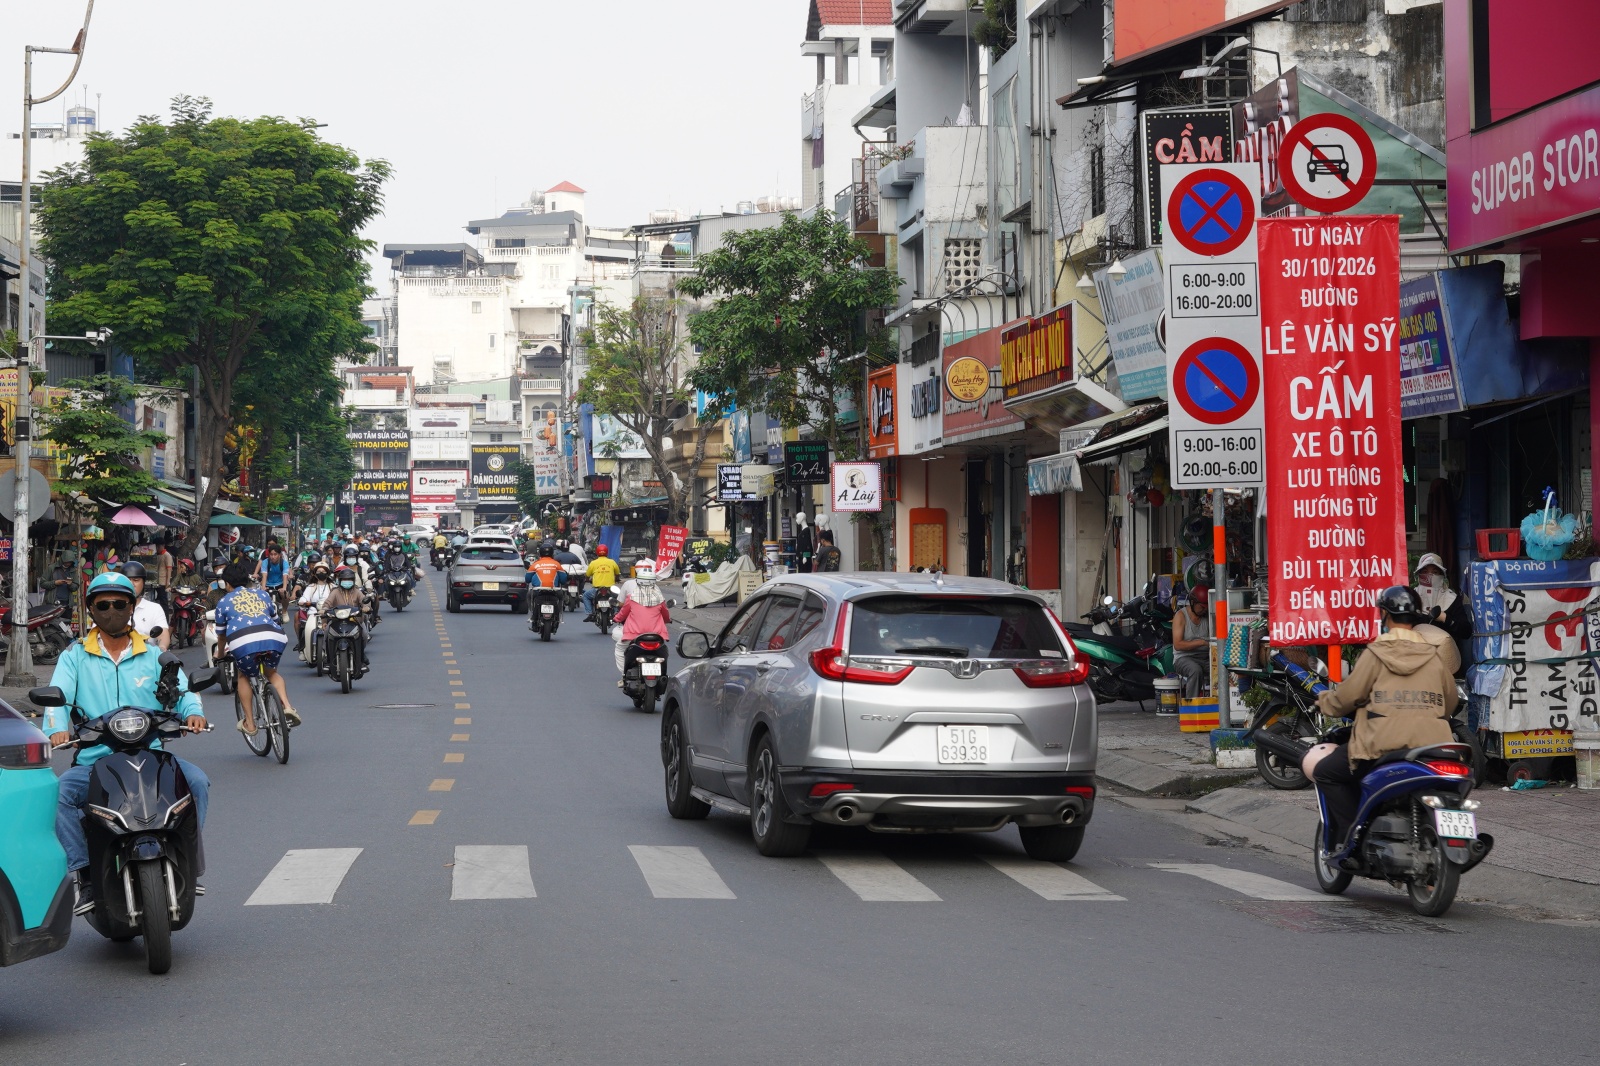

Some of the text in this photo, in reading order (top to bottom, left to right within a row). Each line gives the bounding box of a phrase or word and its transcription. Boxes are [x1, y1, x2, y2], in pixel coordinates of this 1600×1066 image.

[1155, 122, 1223, 164] CẦM
[1292, 221, 1365, 247] TỪ NGÀY
[1281, 256, 1376, 278] 30/10/2026
[1182, 272, 1246, 288] 6:00-9:00
[1176, 294, 1253, 310] 16:00-20:00
[1300, 282, 1359, 308] ĐƯỜNG
[1410, 314, 1424, 336] GAS
[1424, 310, 1438, 333] 406
[1265, 316, 1397, 355] LÊ VĂN SỸ
[1001, 310, 1067, 387] BÚN CHẢ HÀ NỘI
[1289, 359, 1374, 421] CẤM
[363, 431, 376, 439] TÂM
[378, 430, 390, 439] SỬA
[391, 430, 408, 439] CHỮA
[389, 440, 408, 449] ĐỘNG
[1183, 436, 1256, 453] 9:00-16:00
[1292, 425, 1378, 458] XE Ô TÔ
[473, 473, 493, 484] ĐĂNG
[1182, 460, 1258, 477] 20:00-6:00
[1287, 463, 1381, 488] LƯU THÔNG
[353, 481, 408, 492] TÁO VIỆT MỸ
[488, 486, 499, 494] BÁN
[536, 475, 558, 487] 7K
[837, 490, 849, 502] A
[1293, 492, 1378, 518] HƯỚNG TỪ
[1308, 523, 1366, 548] ĐƯỜNG
[1282, 554, 1393, 582] BÙI THỊ XUÂN
[1505, 562, 1521, 574] bộ
[1289, 584, 1326, 610] ĐẾN
[1272, 616, 1331, 641] HOÀNG
[1336, 616, 1370, 639] VĂN
[1506, 621, 1533, 710] Tháng
[1541, 662, 1569, 729] GIẢM
[1570, 660, 1598, 717] ĐẾN
[860, 714, 899, 722] CR-V
[950, 729, 976, 744] 51G
[941, 746, 987, 761] 639.38
[1441, 812, 1469, 824] 59-P3
